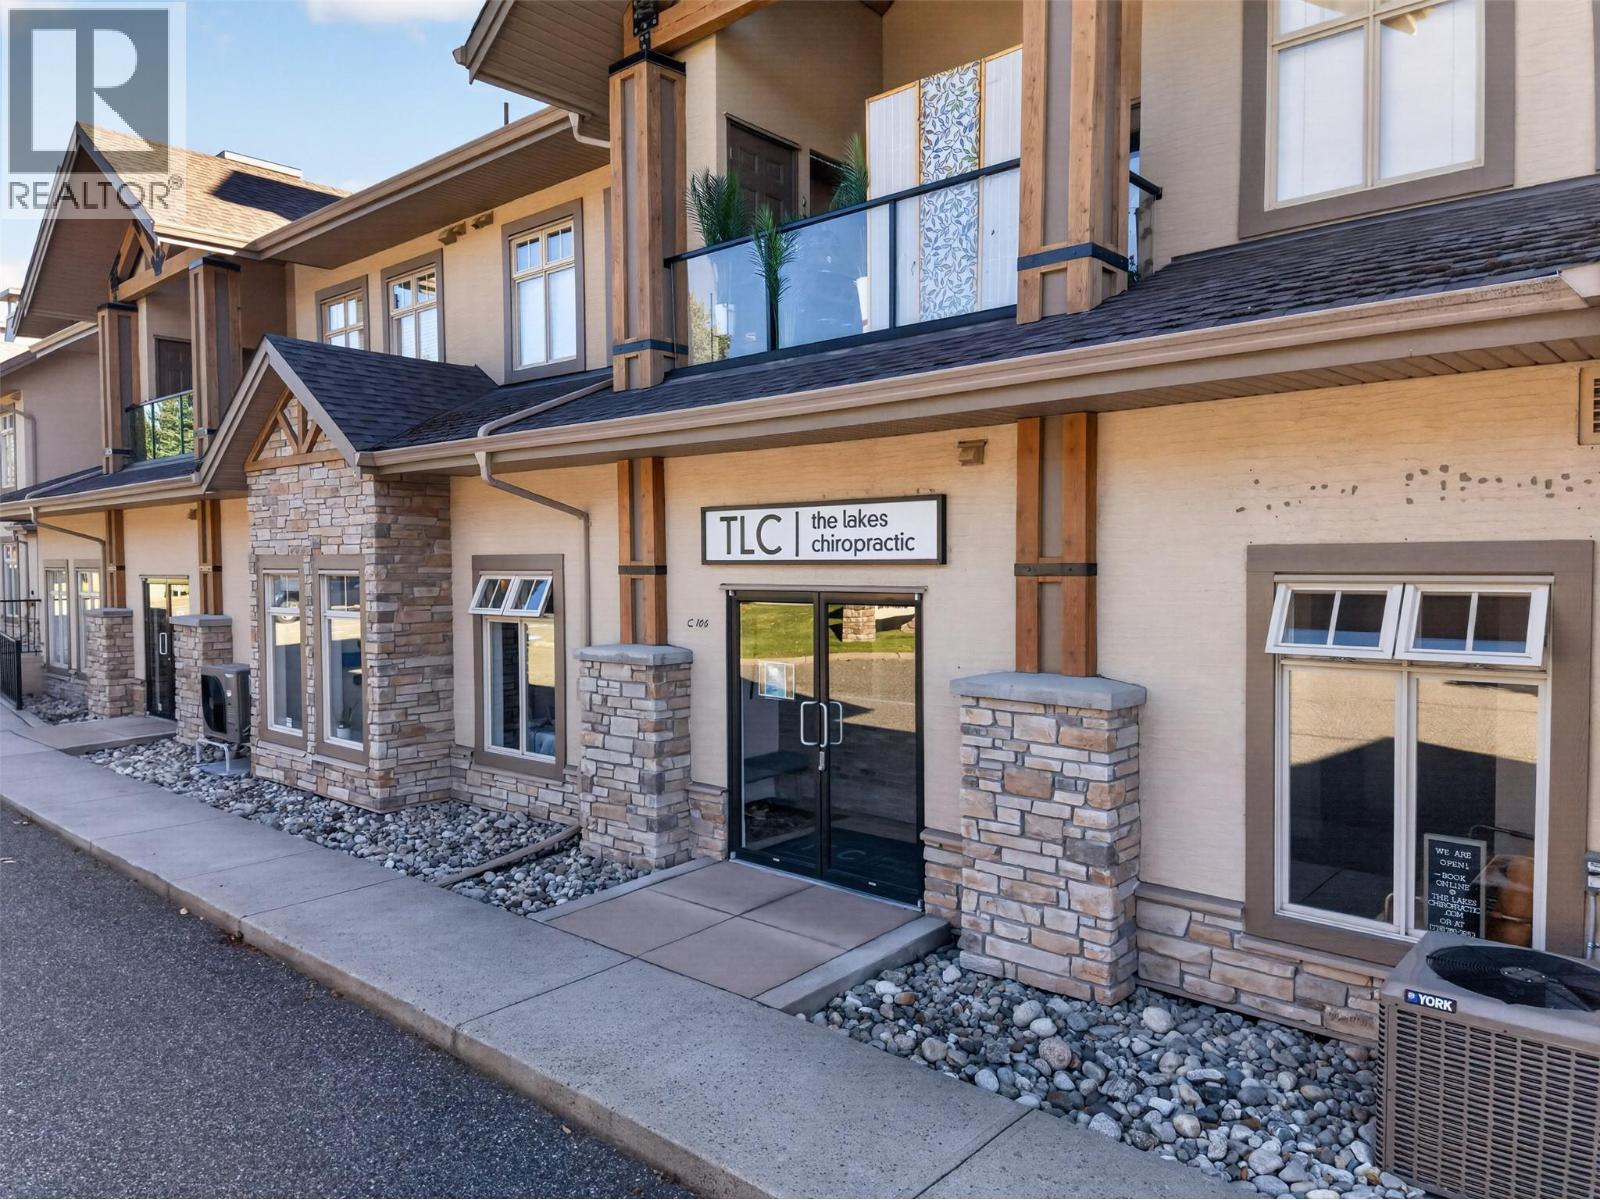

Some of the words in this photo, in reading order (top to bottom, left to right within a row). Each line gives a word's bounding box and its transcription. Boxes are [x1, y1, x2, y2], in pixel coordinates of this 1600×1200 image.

[811, 511, 838, 529] the
[843, 509, 888, 528] lakes
[719, 514, 783, 555] TLC
[811, 532, 915, 557] chiropractic
[696, 618, 709, 628] 106
[1435, 847, 1450, 856] WE
[1454, 850, 1472, 859] ARE
[1440, 859, 1470, 870] OPEN!
[1436, 880, 1470, 891] ONLINE
[1431, 893, 1449, 902] THE
[1452, 896, 1477, 906] LAKES
[1454, 920, 1465, 928] AT
[1418, 993, 1453, 1012] YORK
